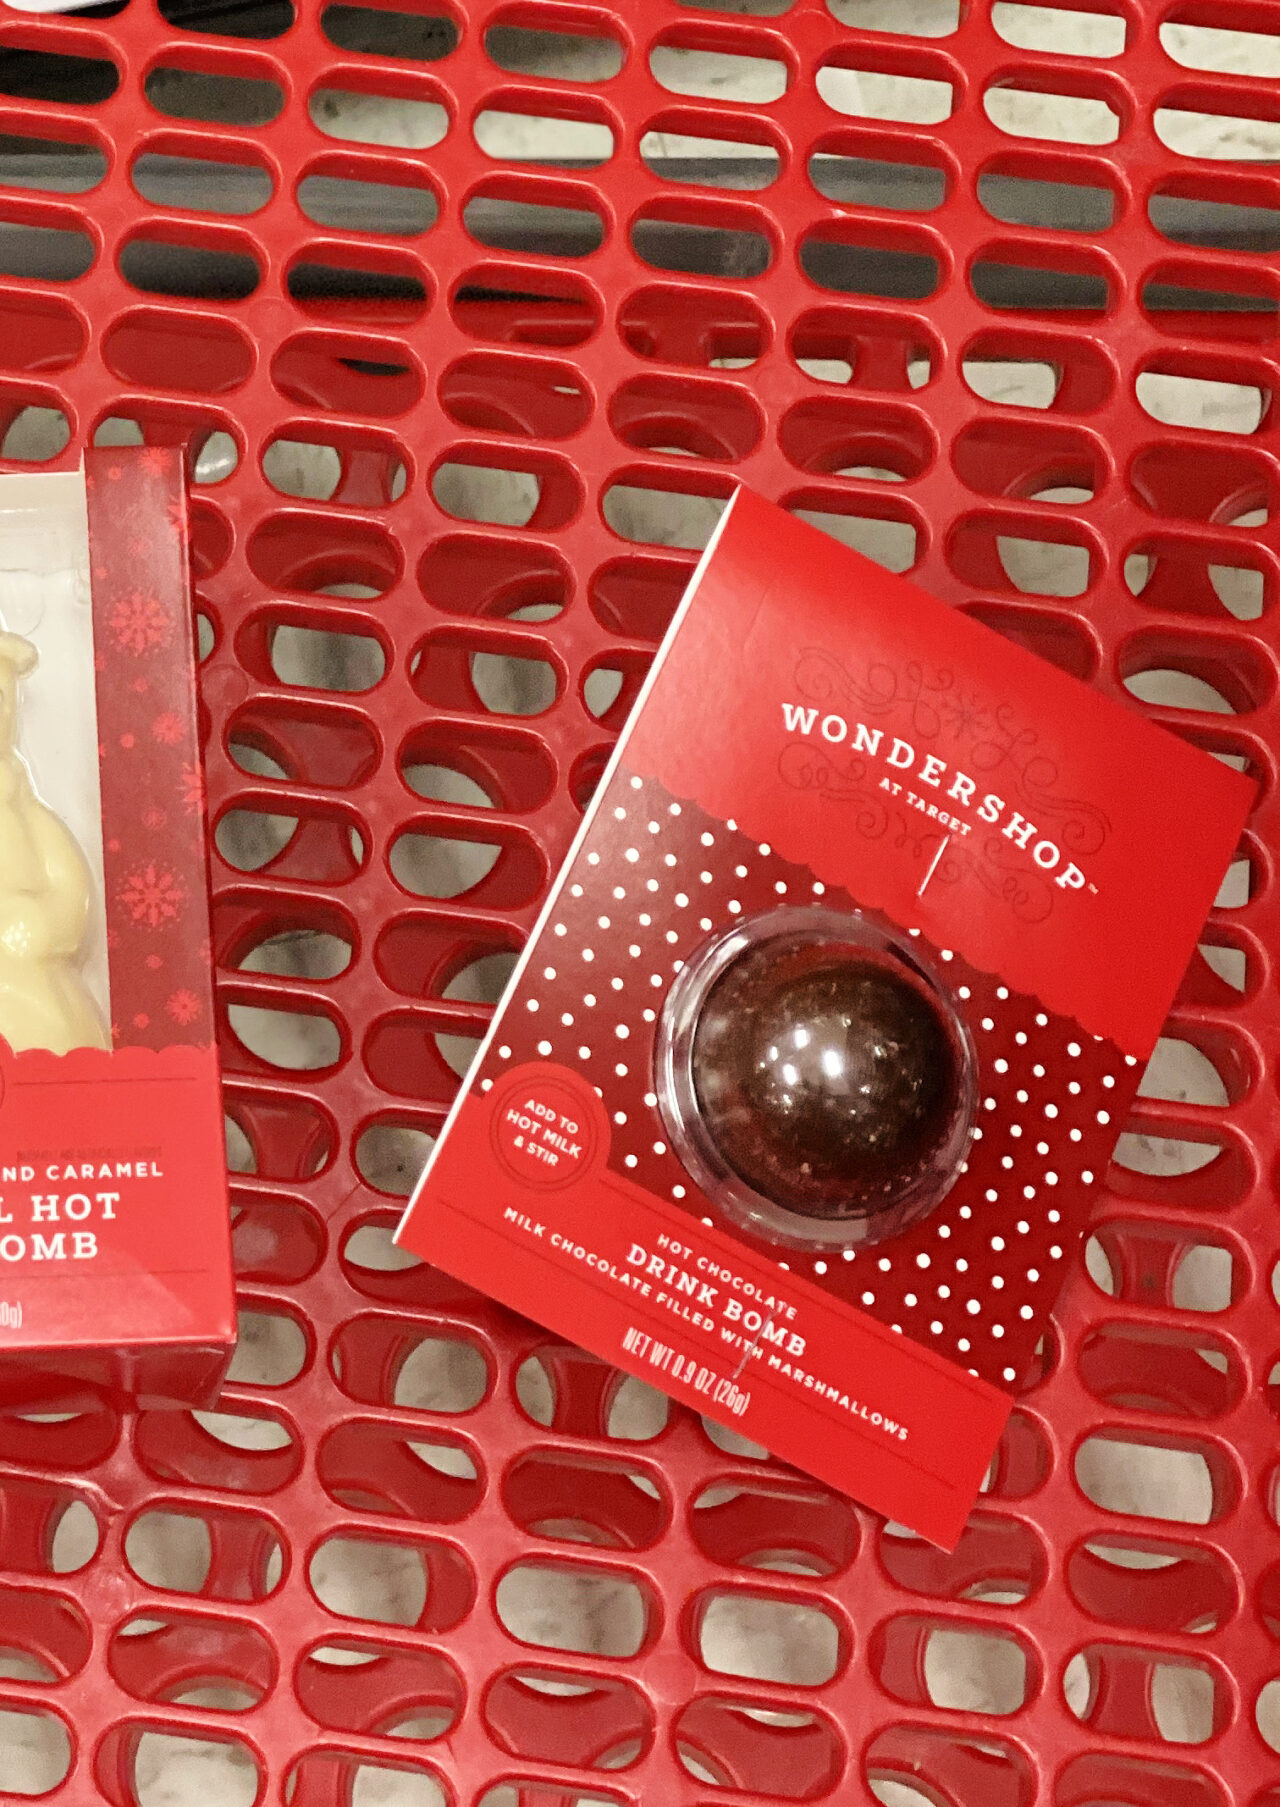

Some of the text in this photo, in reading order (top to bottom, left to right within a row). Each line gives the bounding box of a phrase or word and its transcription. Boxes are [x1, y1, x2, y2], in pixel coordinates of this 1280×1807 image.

[781, 702, 1087, 891] WONDERSHOP
[879, 778, 972, 837] AT TARGET
[506, 1109, 583, 1158] HOT MILK
[524, 1098, 579, 1134] ADD TO
[46, 1161, 164, 1181] CARAMEL
[514, 1136, 559, 1167] & STIR
[31, 1192, 121, 1222] HOT
[626, 1243, 806, 1356] DRINK BOMB
[657, 1234, 798, 1320] HOT CHOCOLATE
[503, 1207, 908, 1441] MILK CHOCOLATE FILLED WITH MARSHMALLOWS
[622, 1326, 752, 1418] NET WT 0.9 OZ (26g)
